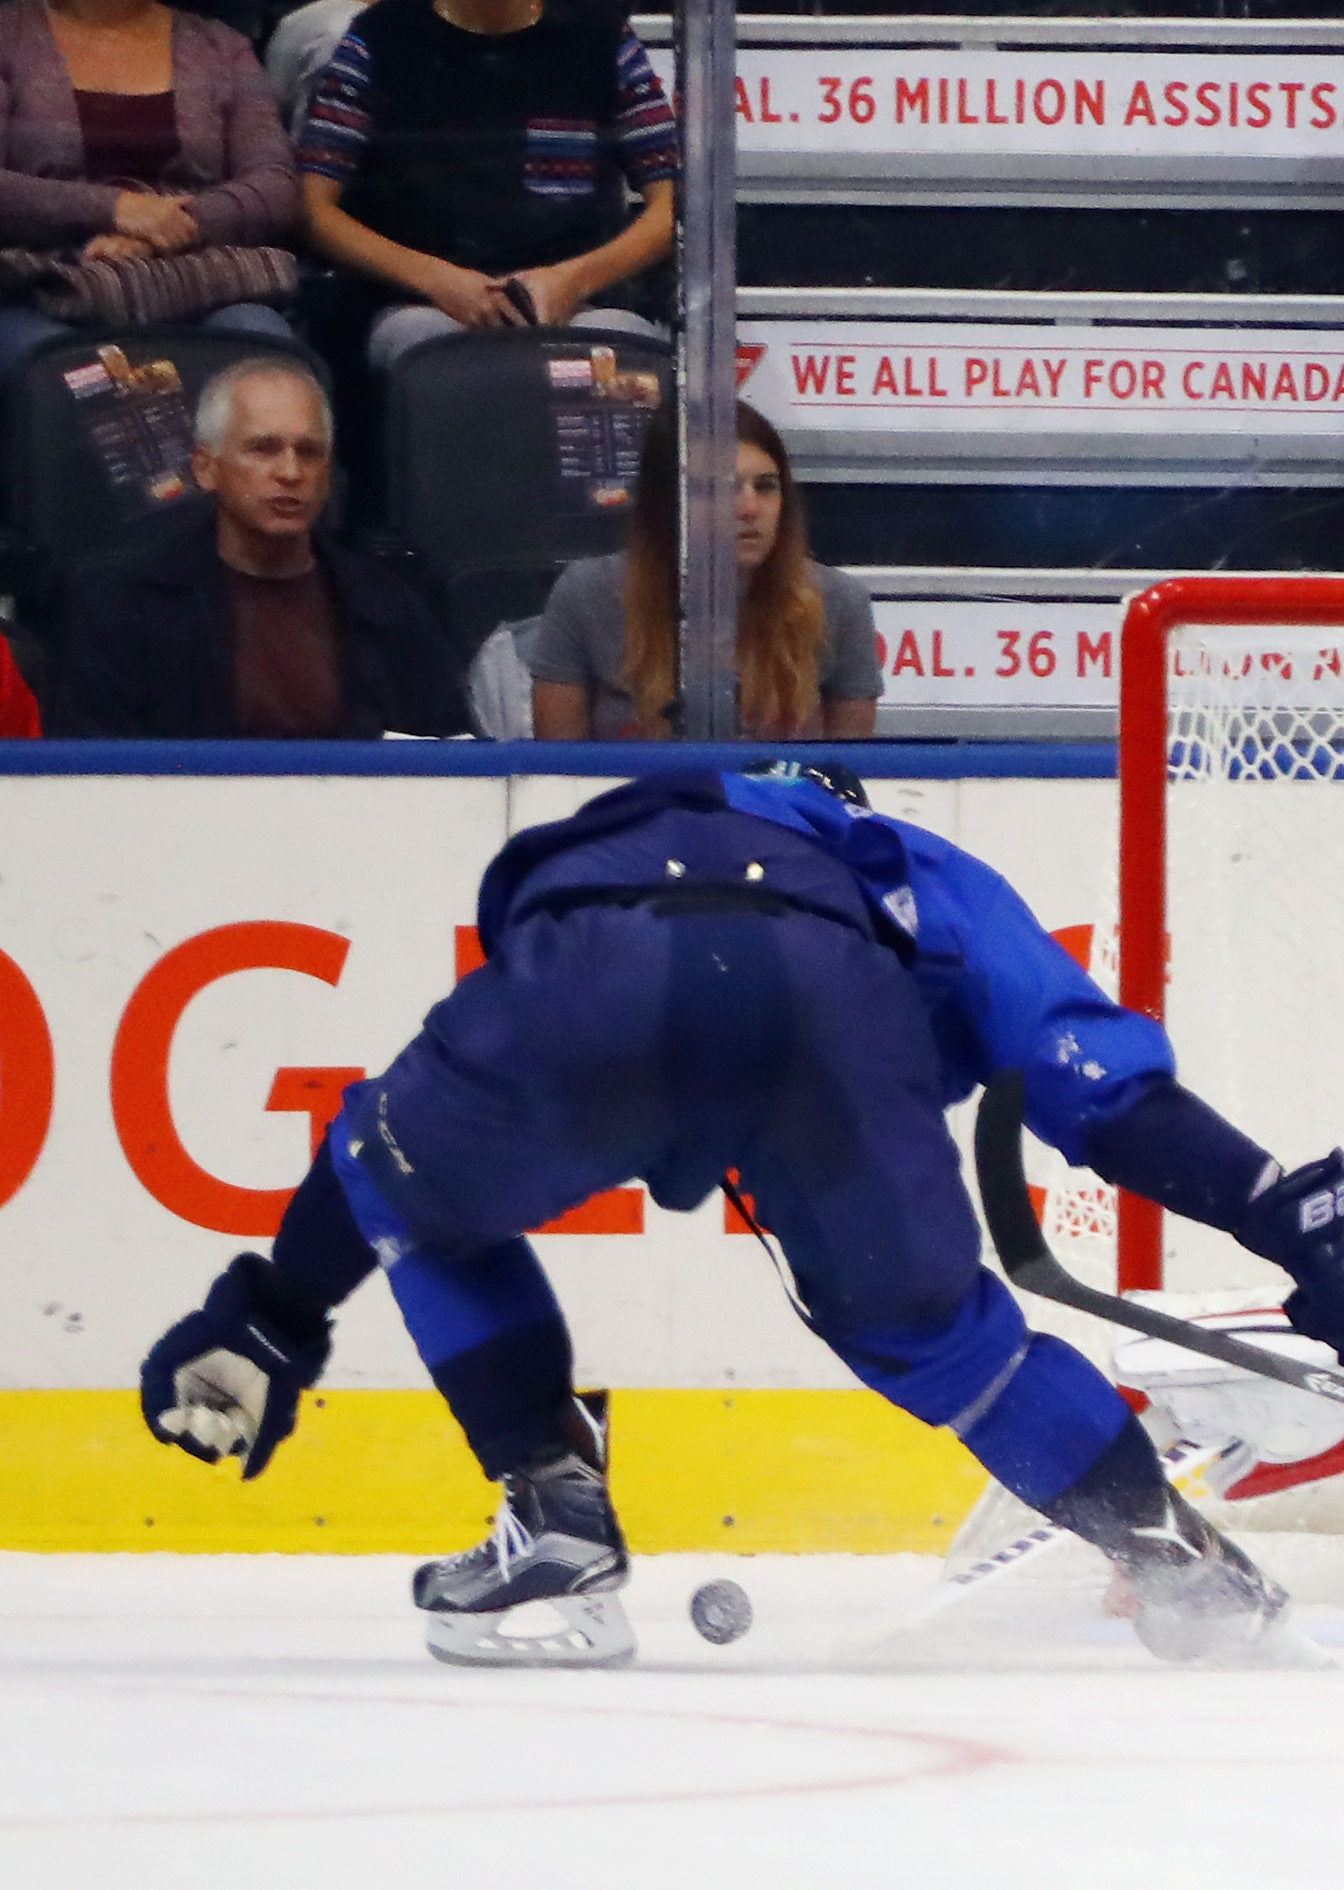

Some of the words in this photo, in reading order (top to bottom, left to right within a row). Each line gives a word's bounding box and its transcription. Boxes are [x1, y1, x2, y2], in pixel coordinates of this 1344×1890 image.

[735, 76, 799, 123] AL.
[818, 76, 876, 124] 36
[895, 77, 1105, 125] MILLION
[792, 354, 857, 395] WE
[872, 356, 948, 398] ALL
[965, 358, 1067, 398] PLAY
[1083, 359, 1166, 399] FOR
[995, 630, 1057, 678] 36
